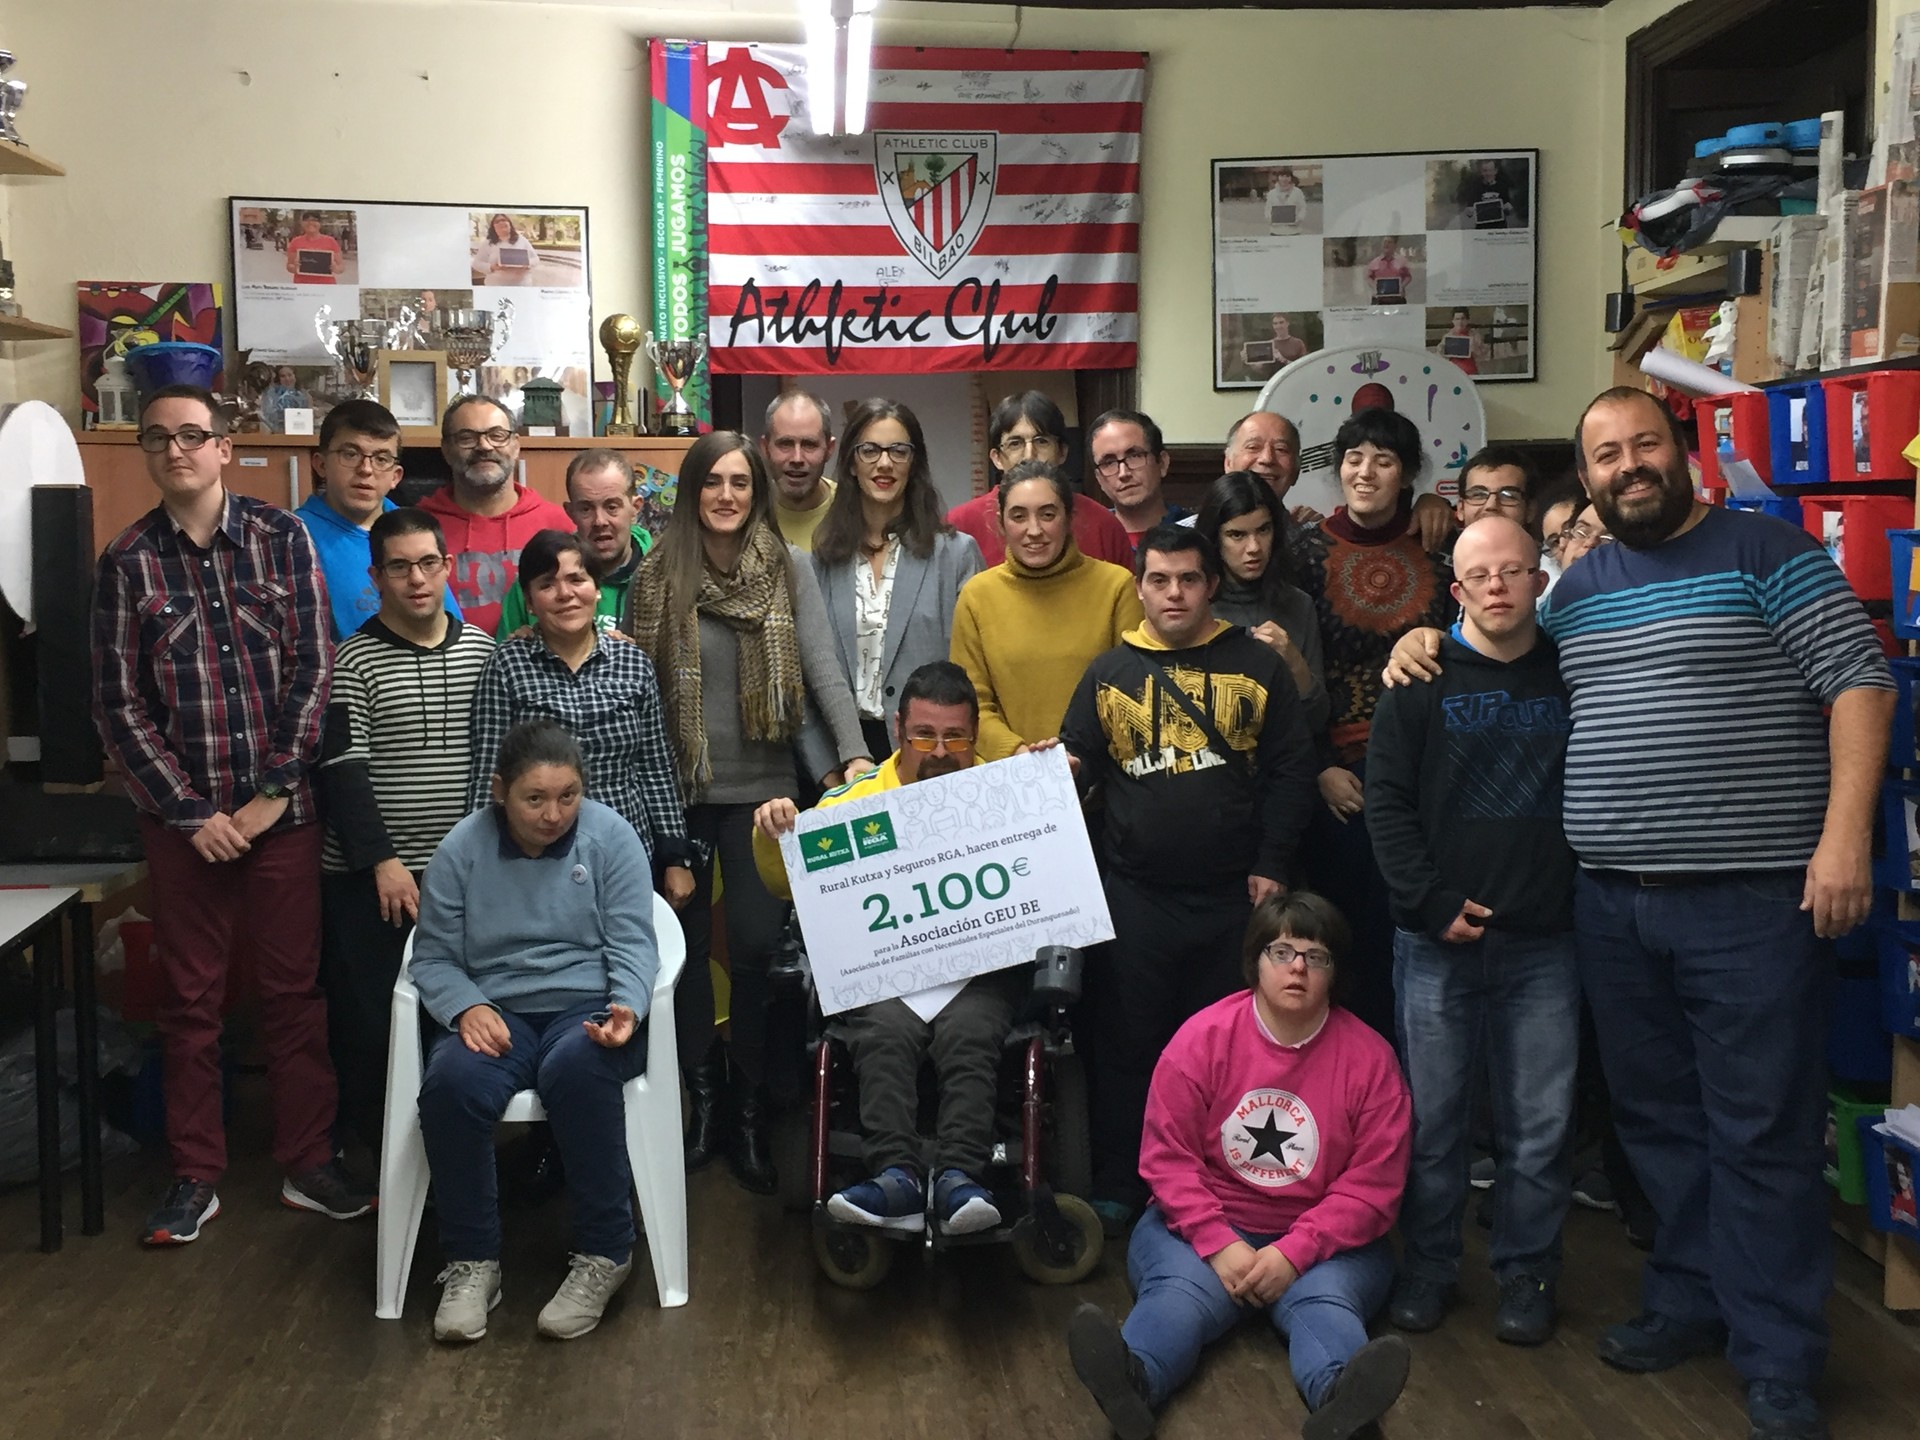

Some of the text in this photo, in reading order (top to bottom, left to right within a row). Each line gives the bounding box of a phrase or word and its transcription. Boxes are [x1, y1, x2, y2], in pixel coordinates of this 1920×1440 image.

[656, 141, 664, 193] FEMENINO
[882, 138, 989, 149] ATHLETIC CLUB
[656, 201, 665, 248] ESCOLAR
[670, 153, 690, 342] TODOS JUGAMOS
[876, 265, 905, 278] ALEX
[914, 233, 964, 272] BILBAO
[657, 257, 667, 309] INCLUSIVO
[728, 274, 1058, 366] Athletic Club
[807, 854, 828, 864] RURAL
[820, 822, 1058, 894] Rural Kutxa y Seguros RGA, hacen entrega de
[840, 960, 880, 977] (Asociación
[881, 957, 890, 966] de
[891, 950, 920, 963] Familias
[921, 946, 934, 955] con
[934, 936, 977, 952] Necesidades
[978, 924, 1014, 939] Especiales
[1014, 919, 1026, 930] del
[873, 899, 1041, 957] para la Asociación GEU BE
[1236, 1095, 1306, 1127] MALLORCA
[1229, 1147, 1305, 1179] IS DIFFERENT
